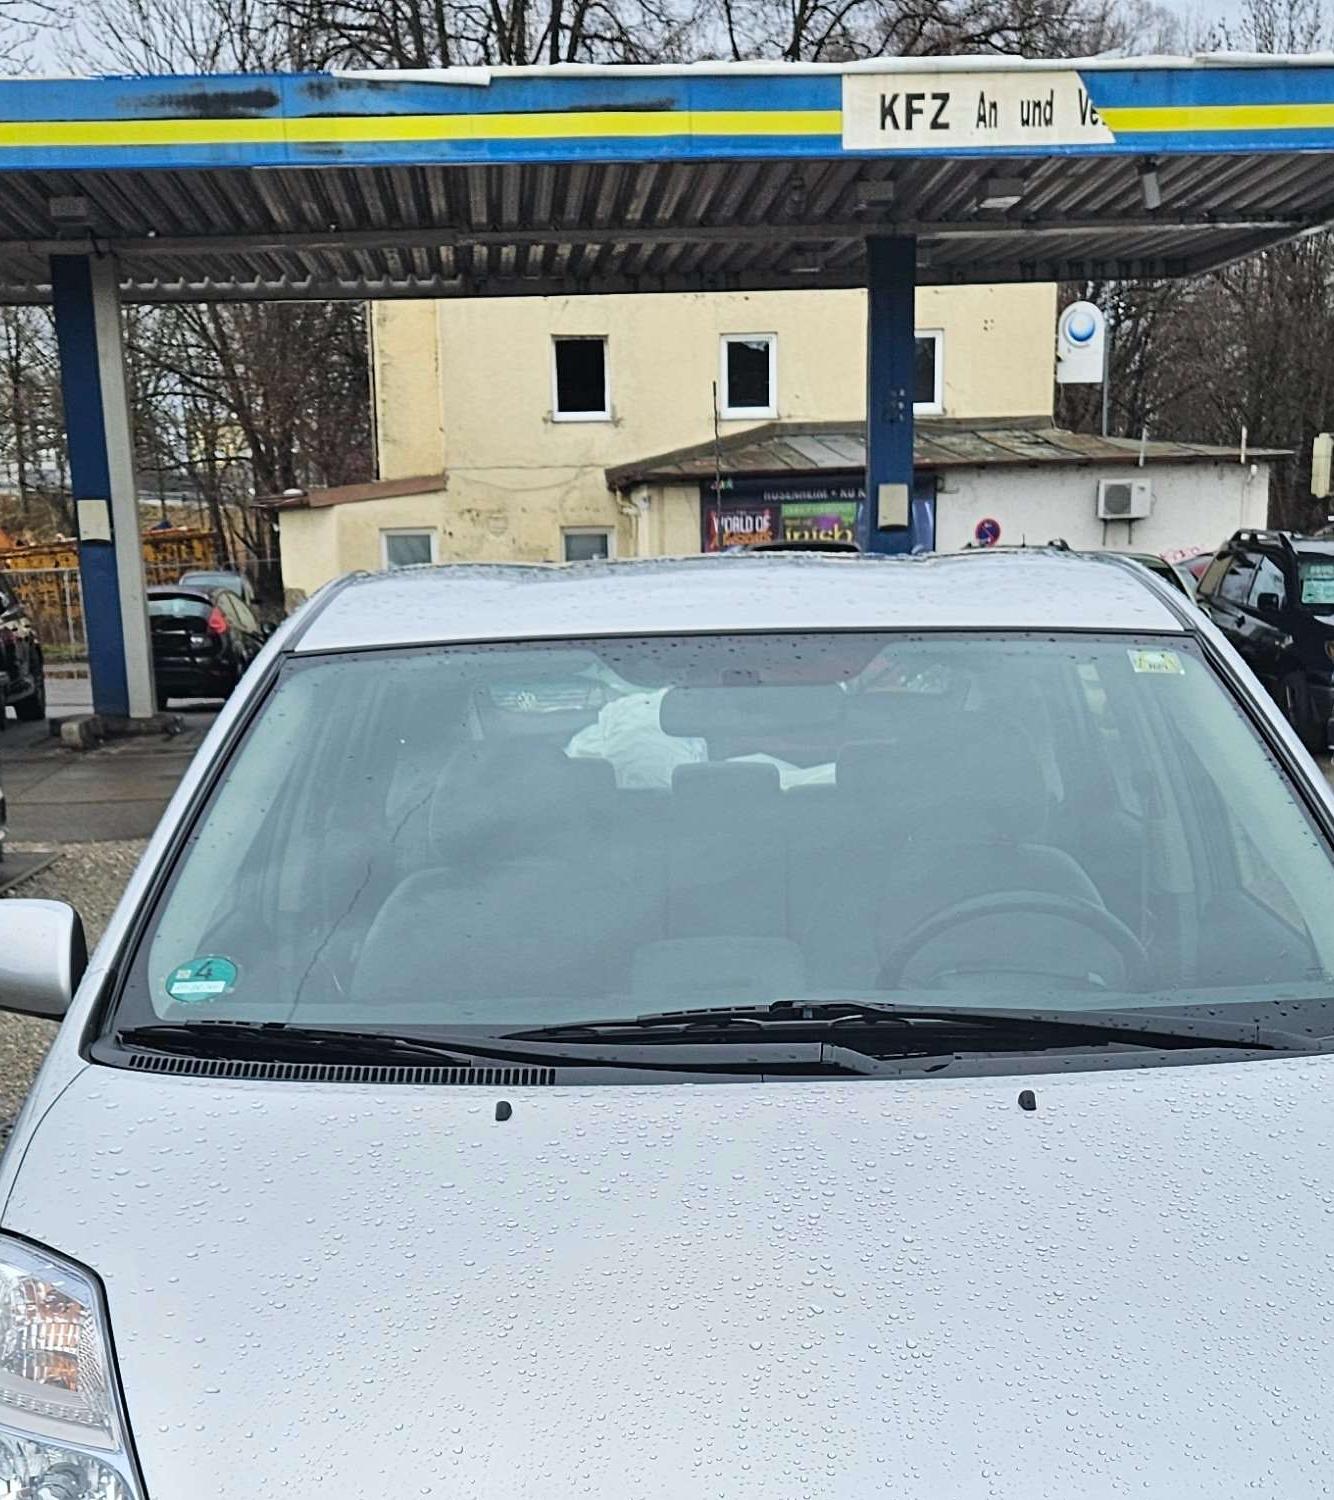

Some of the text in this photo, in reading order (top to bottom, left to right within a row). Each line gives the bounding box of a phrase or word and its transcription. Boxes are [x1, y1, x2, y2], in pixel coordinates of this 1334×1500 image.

[880, 88, 1107, 130] KFZ An und Ve
[195, 960, 213, 980] 4
